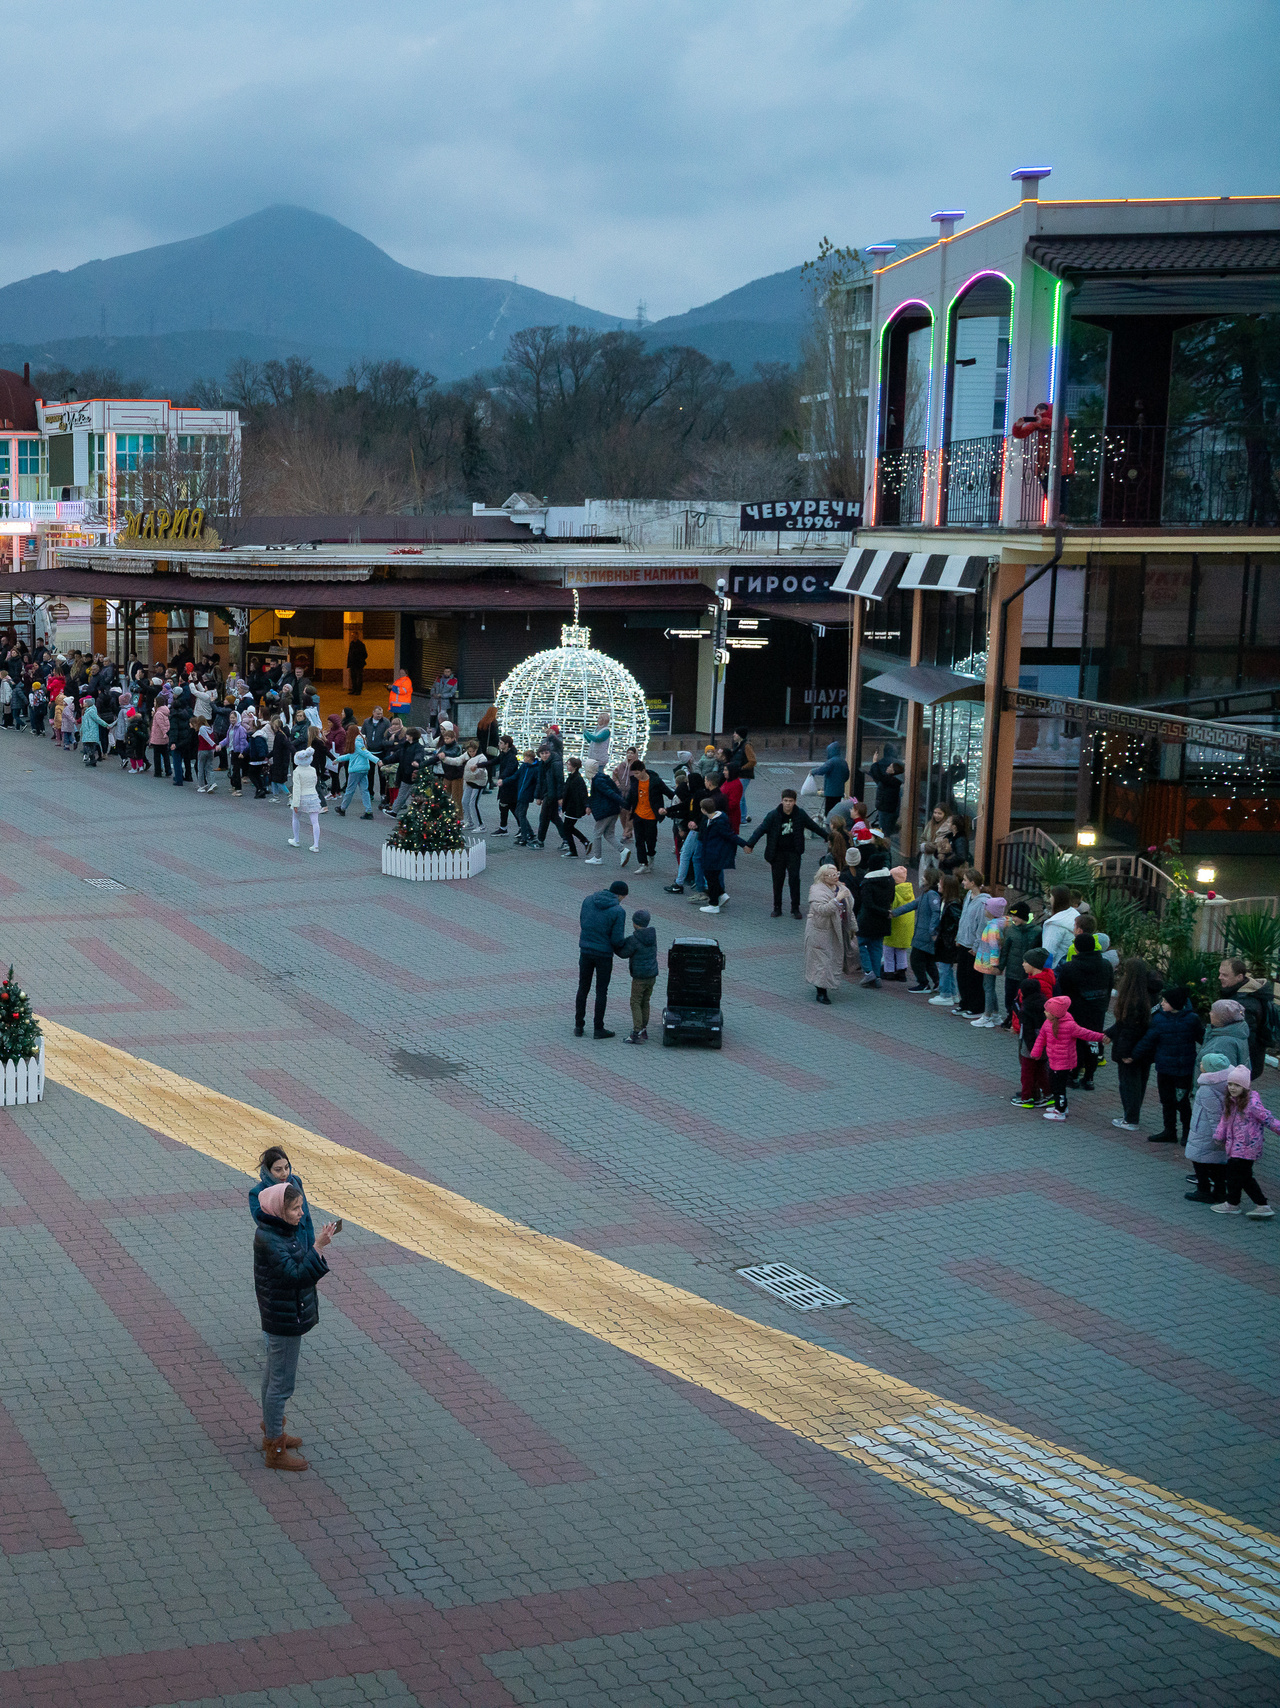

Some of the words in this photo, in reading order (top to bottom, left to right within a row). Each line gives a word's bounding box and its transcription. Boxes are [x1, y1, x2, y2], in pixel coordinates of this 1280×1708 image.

[745, 500, 863, 520] ЧЕБУРЕЧН
[124, 507, 205, 539] МАРИЯ
[568, 569, 641, 584] РАЗЛИВНЫЕ
[643, 567, 699, 582] НАПИТКИ
[733, 575, 817, 593] ГИРОС
